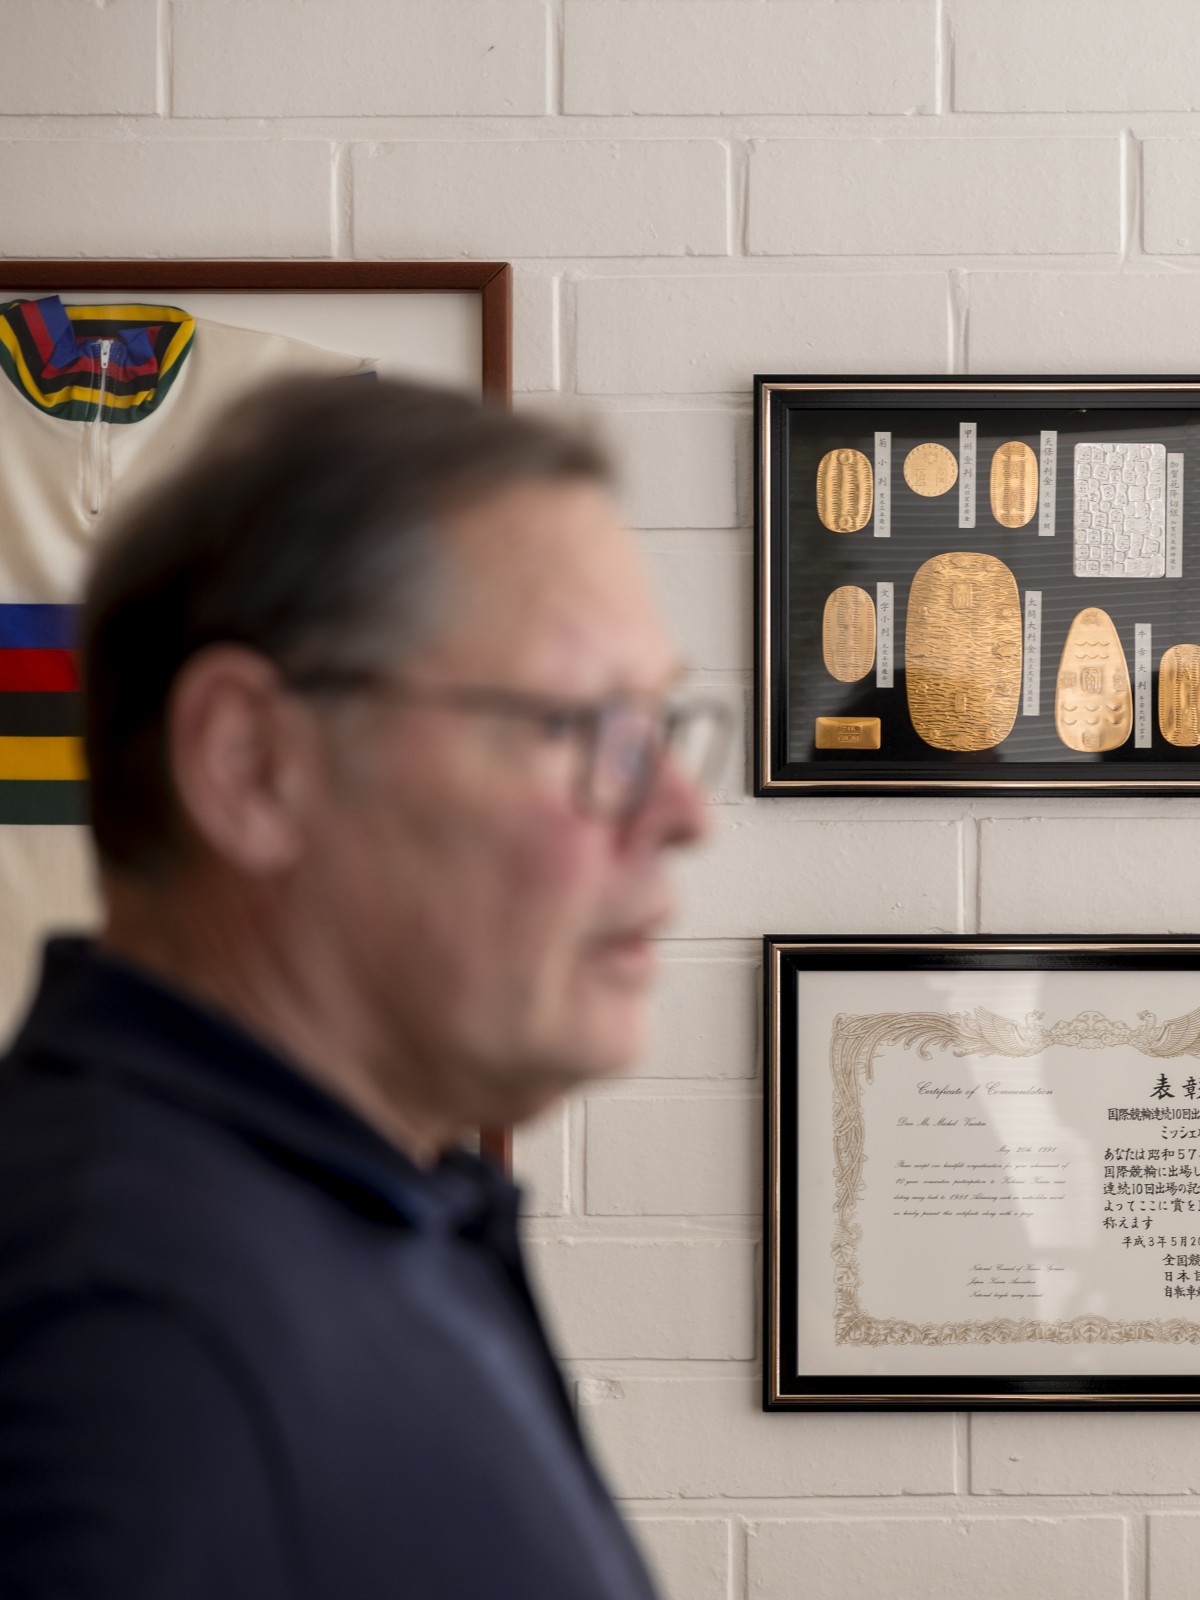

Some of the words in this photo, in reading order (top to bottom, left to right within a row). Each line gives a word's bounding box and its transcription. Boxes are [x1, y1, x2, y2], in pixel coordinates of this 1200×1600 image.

[962, 429, 972, 478] 甲州金判
[880, 589, 891, 637] 文字小判
[916, 1081, 963, 1099] Certificate
[965, 1084, 981, 1100] of
[985, 1081, 1053, 1095] Commendation
[1102, 1215, 1154, 1230] 称えます
